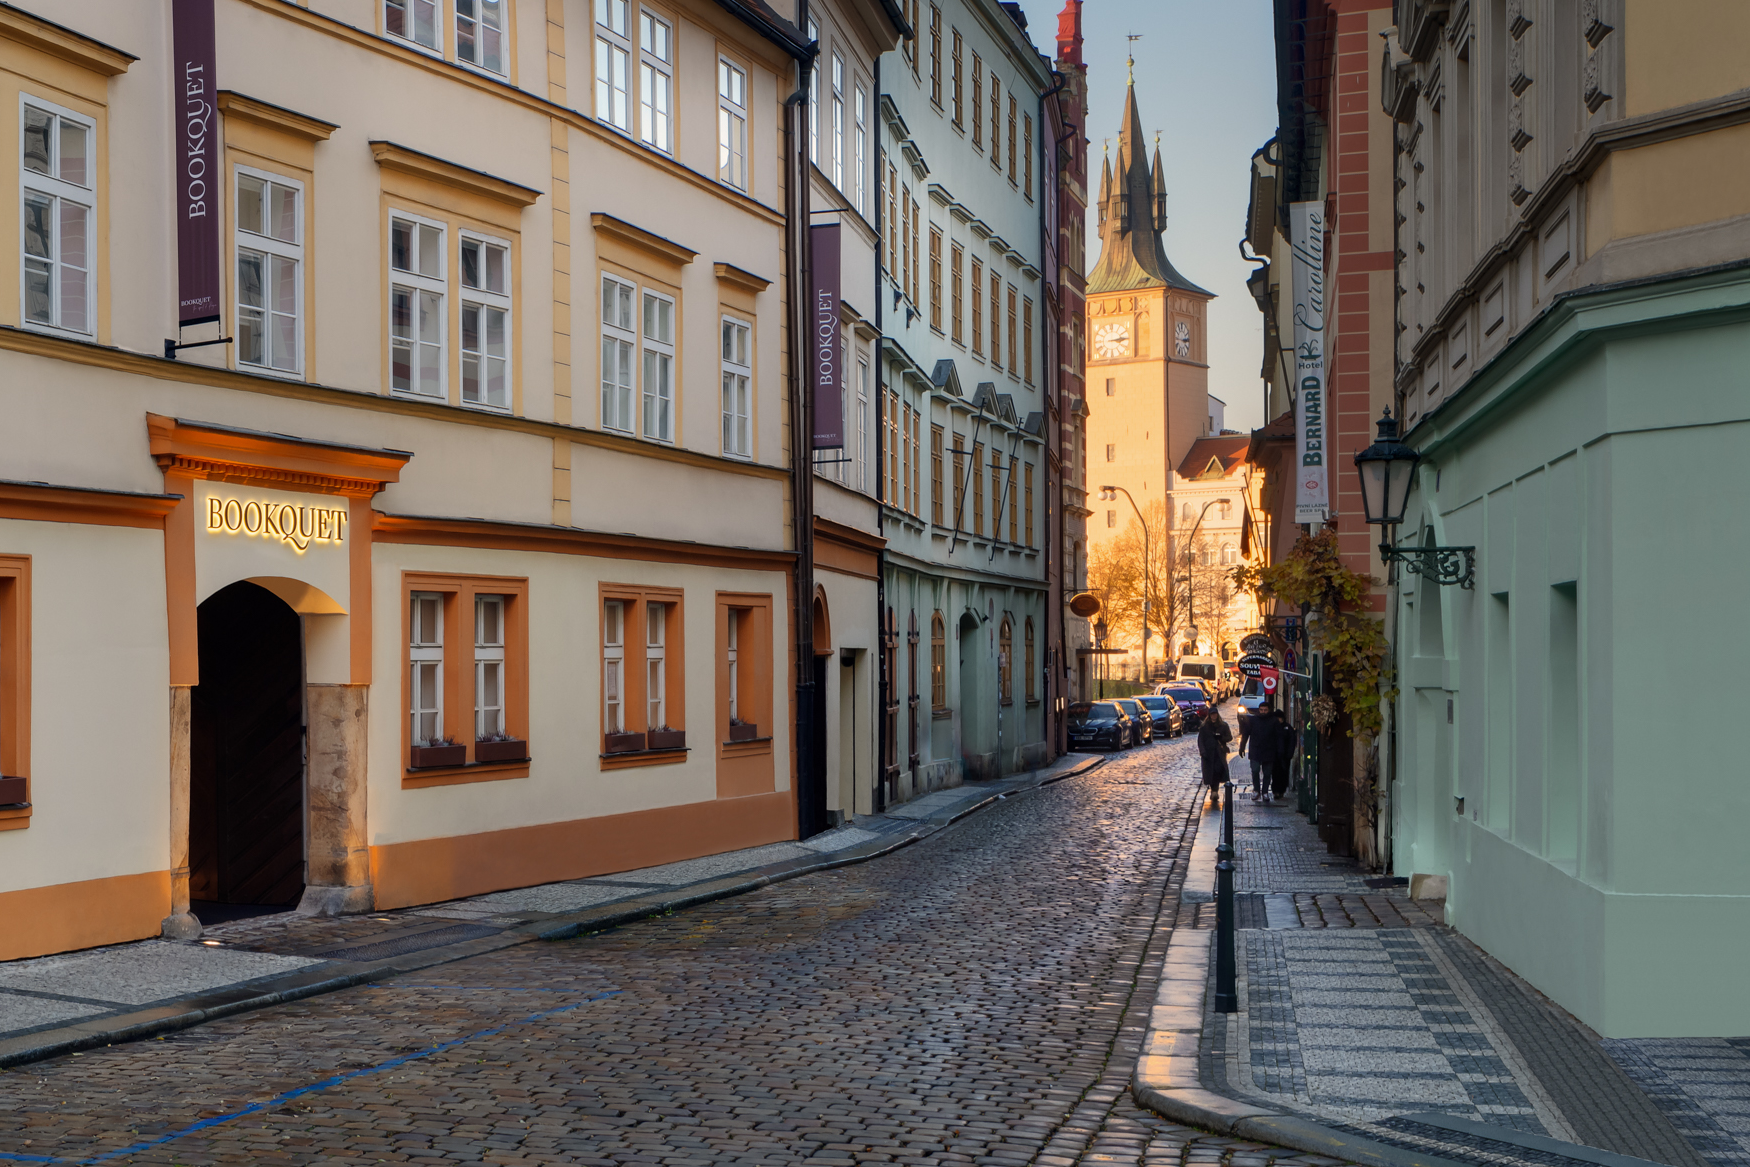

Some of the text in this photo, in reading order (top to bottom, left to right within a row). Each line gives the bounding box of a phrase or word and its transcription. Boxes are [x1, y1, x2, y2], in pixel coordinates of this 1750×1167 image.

[186, 61, 212, 220] BOOKQUET
[181, 296, 211, 306] BOOKQUET
[1293, 211, 1324, 331] Carolline
[818, 289, 838, 386] BOOKQUET
[1298, 361, 1323, 370] Hotel
[1302, 375, 1322, 467] BERNARD
[207, 498, 348, 550] BOOKQUET
